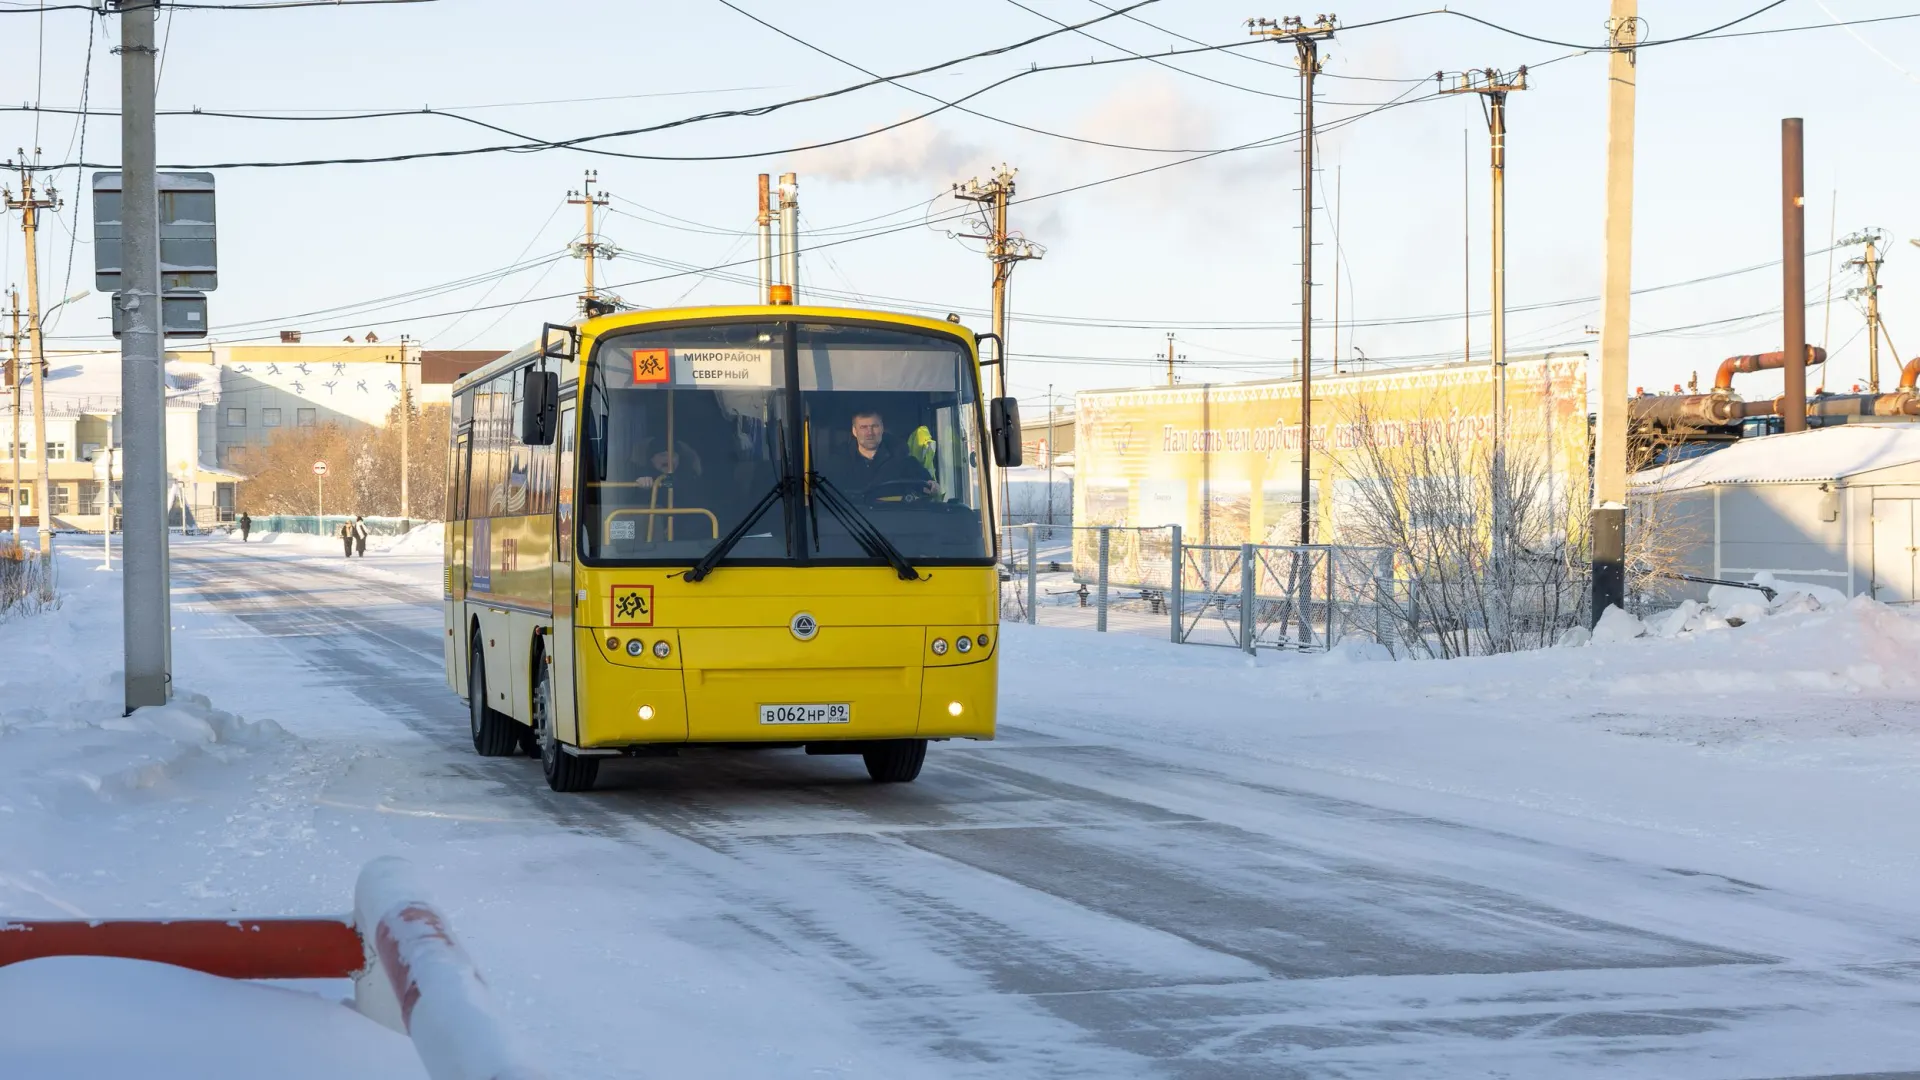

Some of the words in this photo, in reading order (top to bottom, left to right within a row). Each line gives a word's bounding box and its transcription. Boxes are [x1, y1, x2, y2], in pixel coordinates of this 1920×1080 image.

[683, 351, 761, 362] МИКРОРАЙОН
[692, 369, 749, 379] СЕВЕРНЫЙ
[1162, 425, 1188, 452] Нам
[1191, 429, 1222, 452] есть
[1226, 430, 1250, 452] чем
[1253, 418, 1330, 459] гордится,
[1445, 406, 1512, 453] береч!
[829, 705, 845, 717] 89
